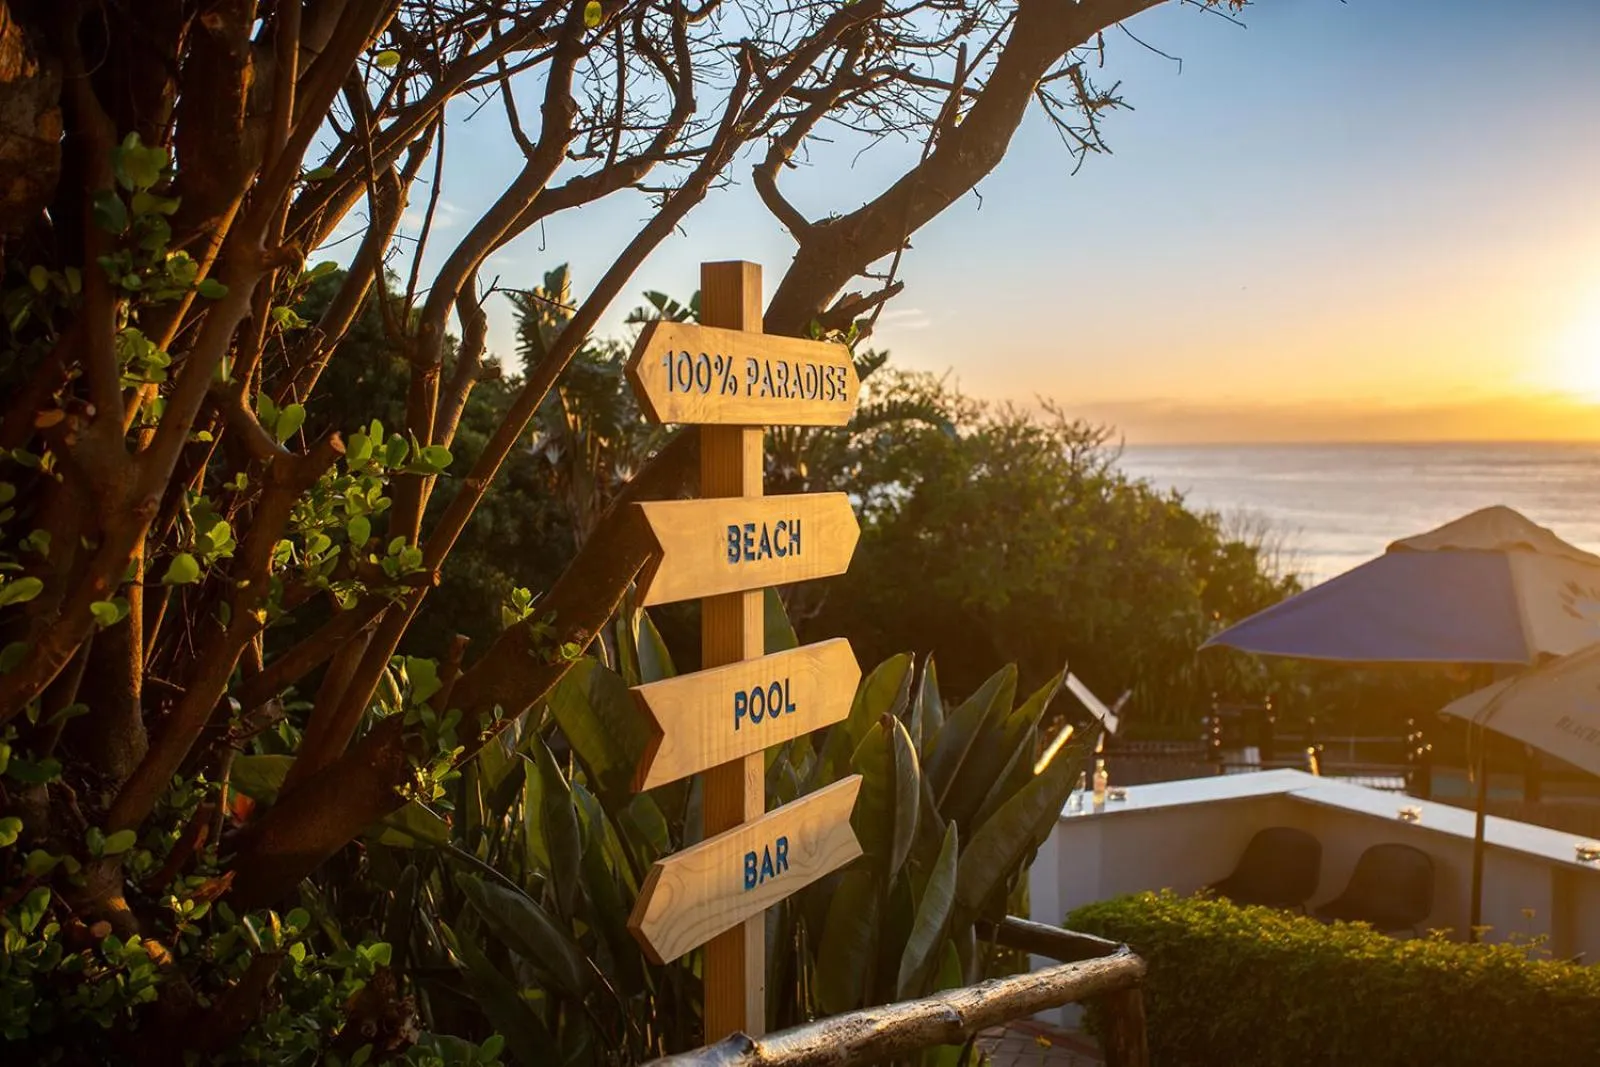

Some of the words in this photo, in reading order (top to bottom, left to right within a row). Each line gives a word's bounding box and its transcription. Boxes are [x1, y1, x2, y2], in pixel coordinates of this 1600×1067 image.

[663, 350, 738, 396] 100%
[746, 357, 847, 401] PARADISE
[727, 519, 802, 564] BEACH
[735, 678, 796, 730] POOL
[744, 836, 789, 892] BAR
